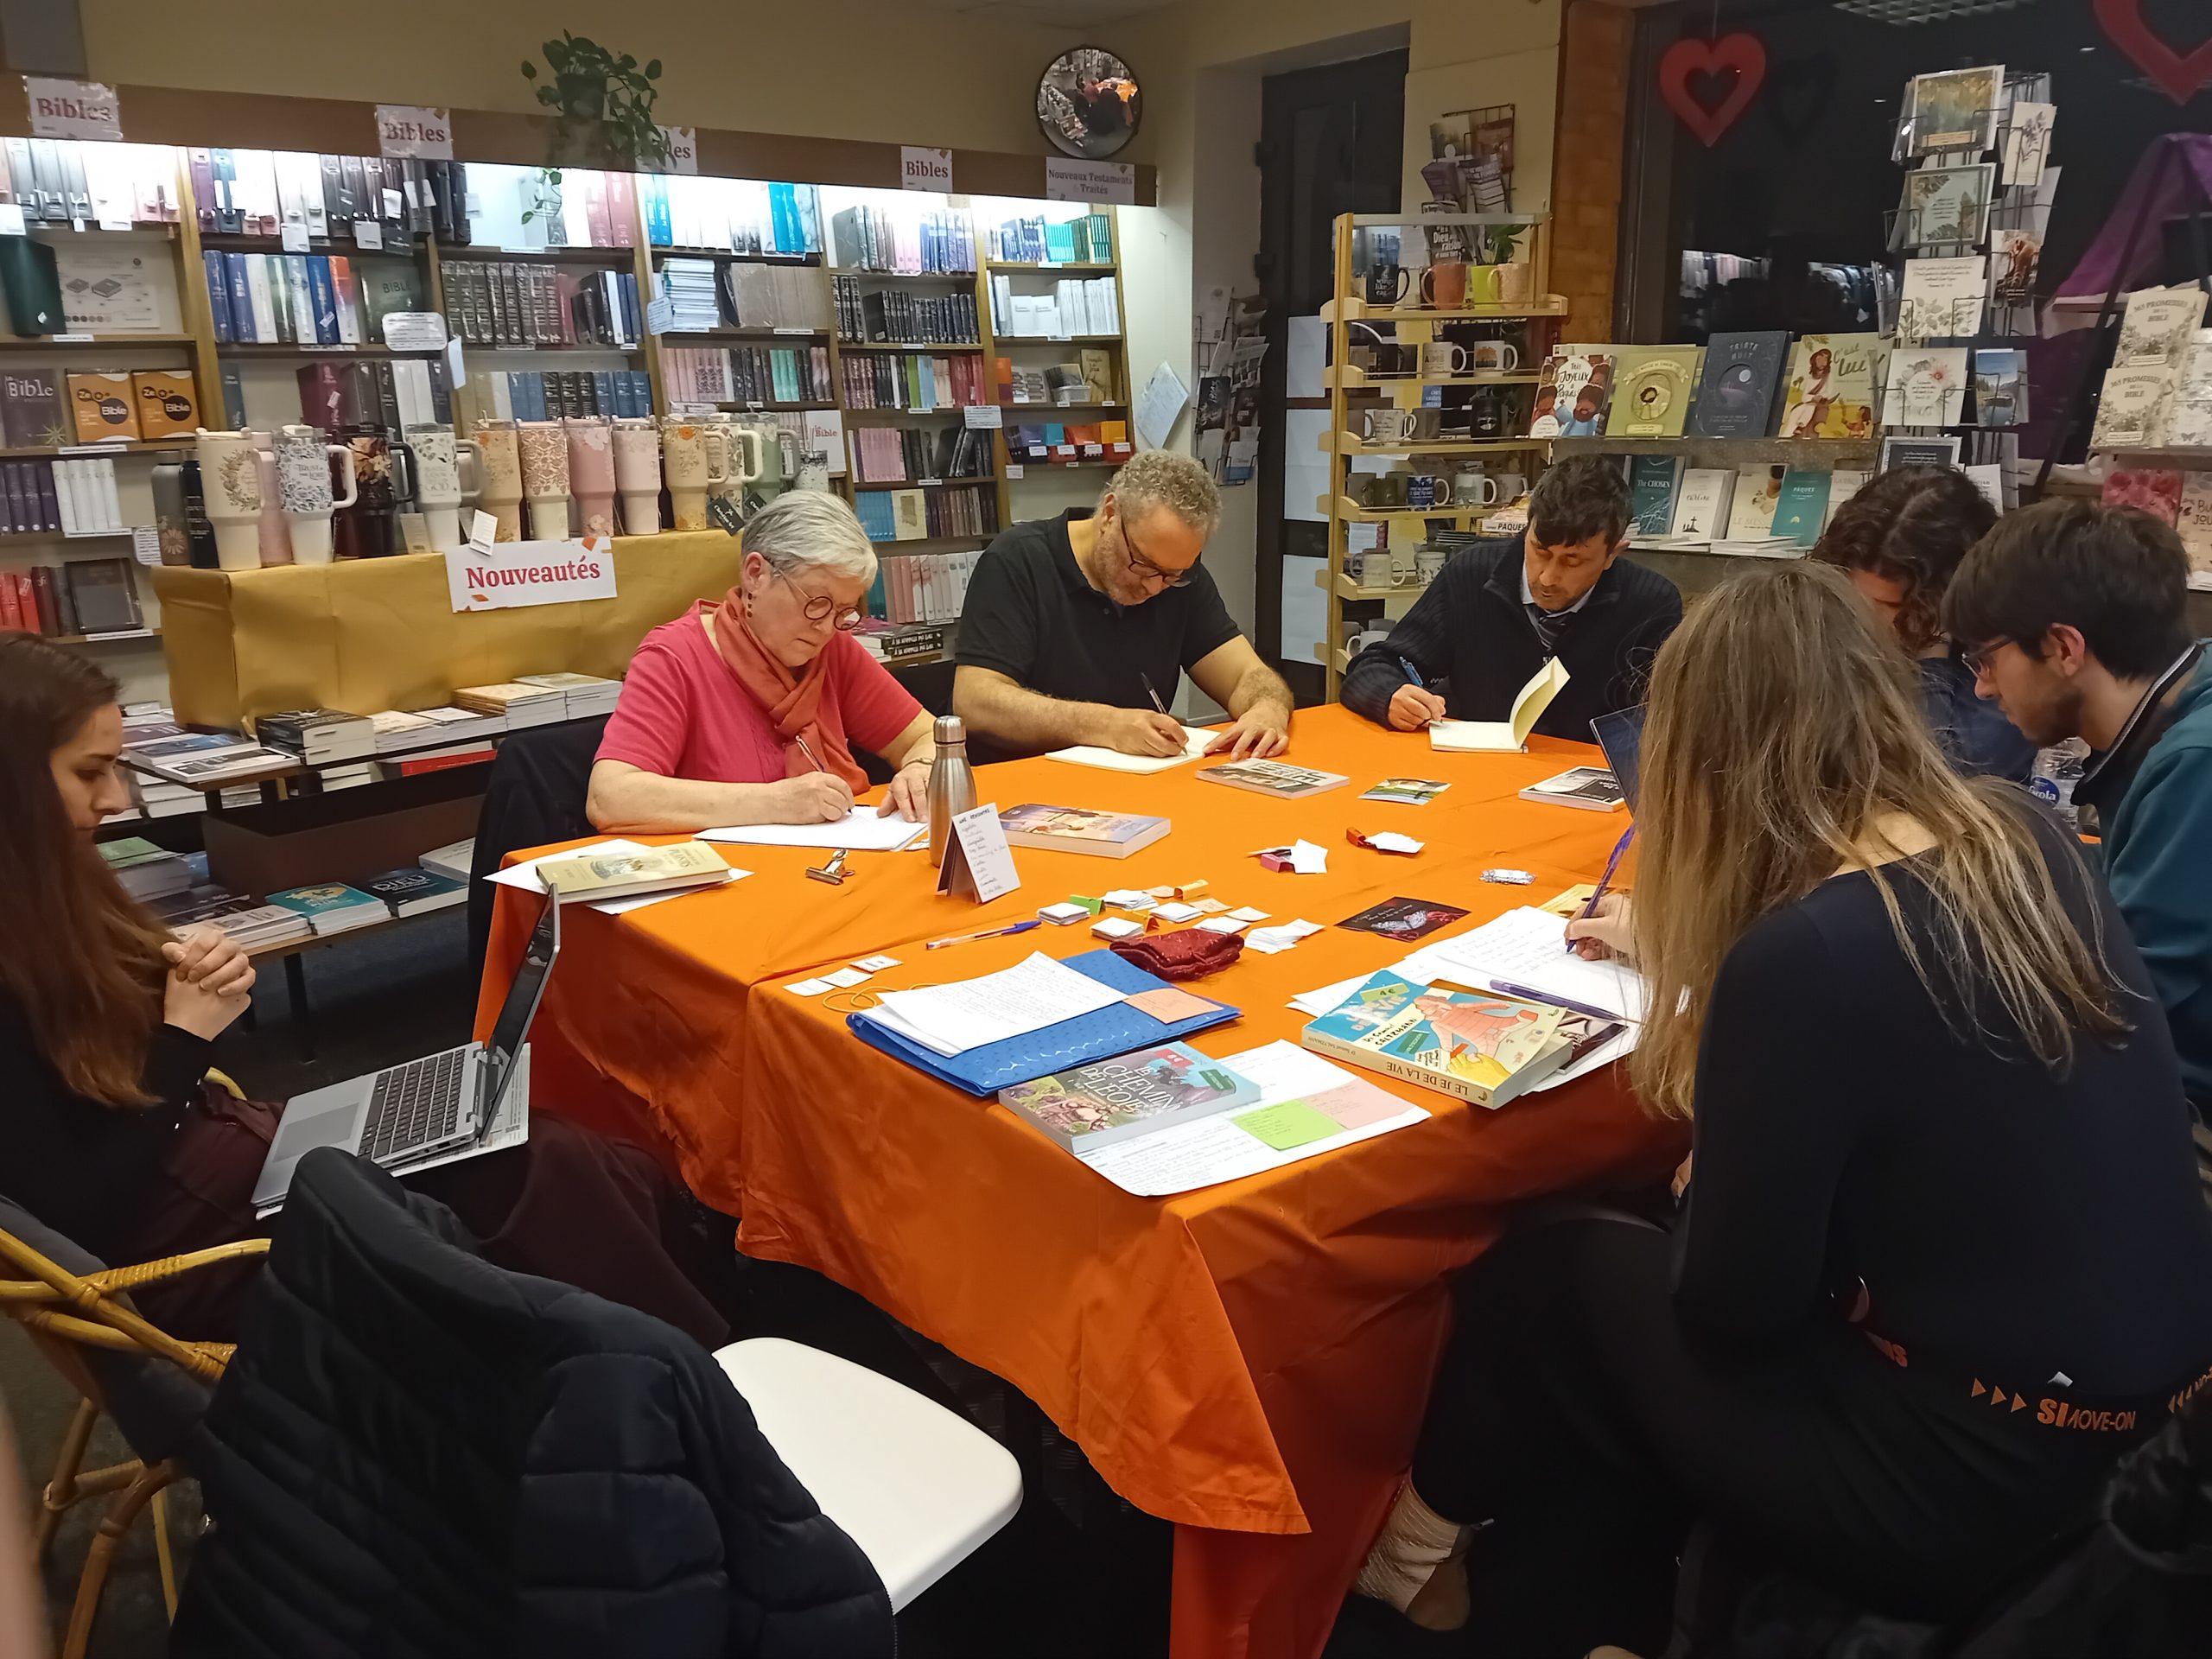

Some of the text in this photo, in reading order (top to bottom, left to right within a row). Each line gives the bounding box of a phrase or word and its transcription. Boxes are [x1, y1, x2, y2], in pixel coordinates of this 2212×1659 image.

[35, 97, 112, 122] Bibles
[385, 122, 446, 143] Bibles
[905, 161, 949, 179] Bibles
[1048, 168, 1133, 186] Nouveaux Testaments
[1080, 182, 1109, 195] Traités
[2122, 375, 2162, 385] PROMESSES
[100, 404, 128, 416] Bible
[165, 402, 191, 413] Bible
[815, 429, 838, 438] Bible
[1646, 480, 1672, 489] CHOSEN
[465, 555, 601, 589] Nouveautés
[1080, 1067, 1103, 1081] DE
[1386, 1061, 1469, 1096] LE JE DE LA VIE
[1103, 1065, 1176, 1109] CHEMIN
